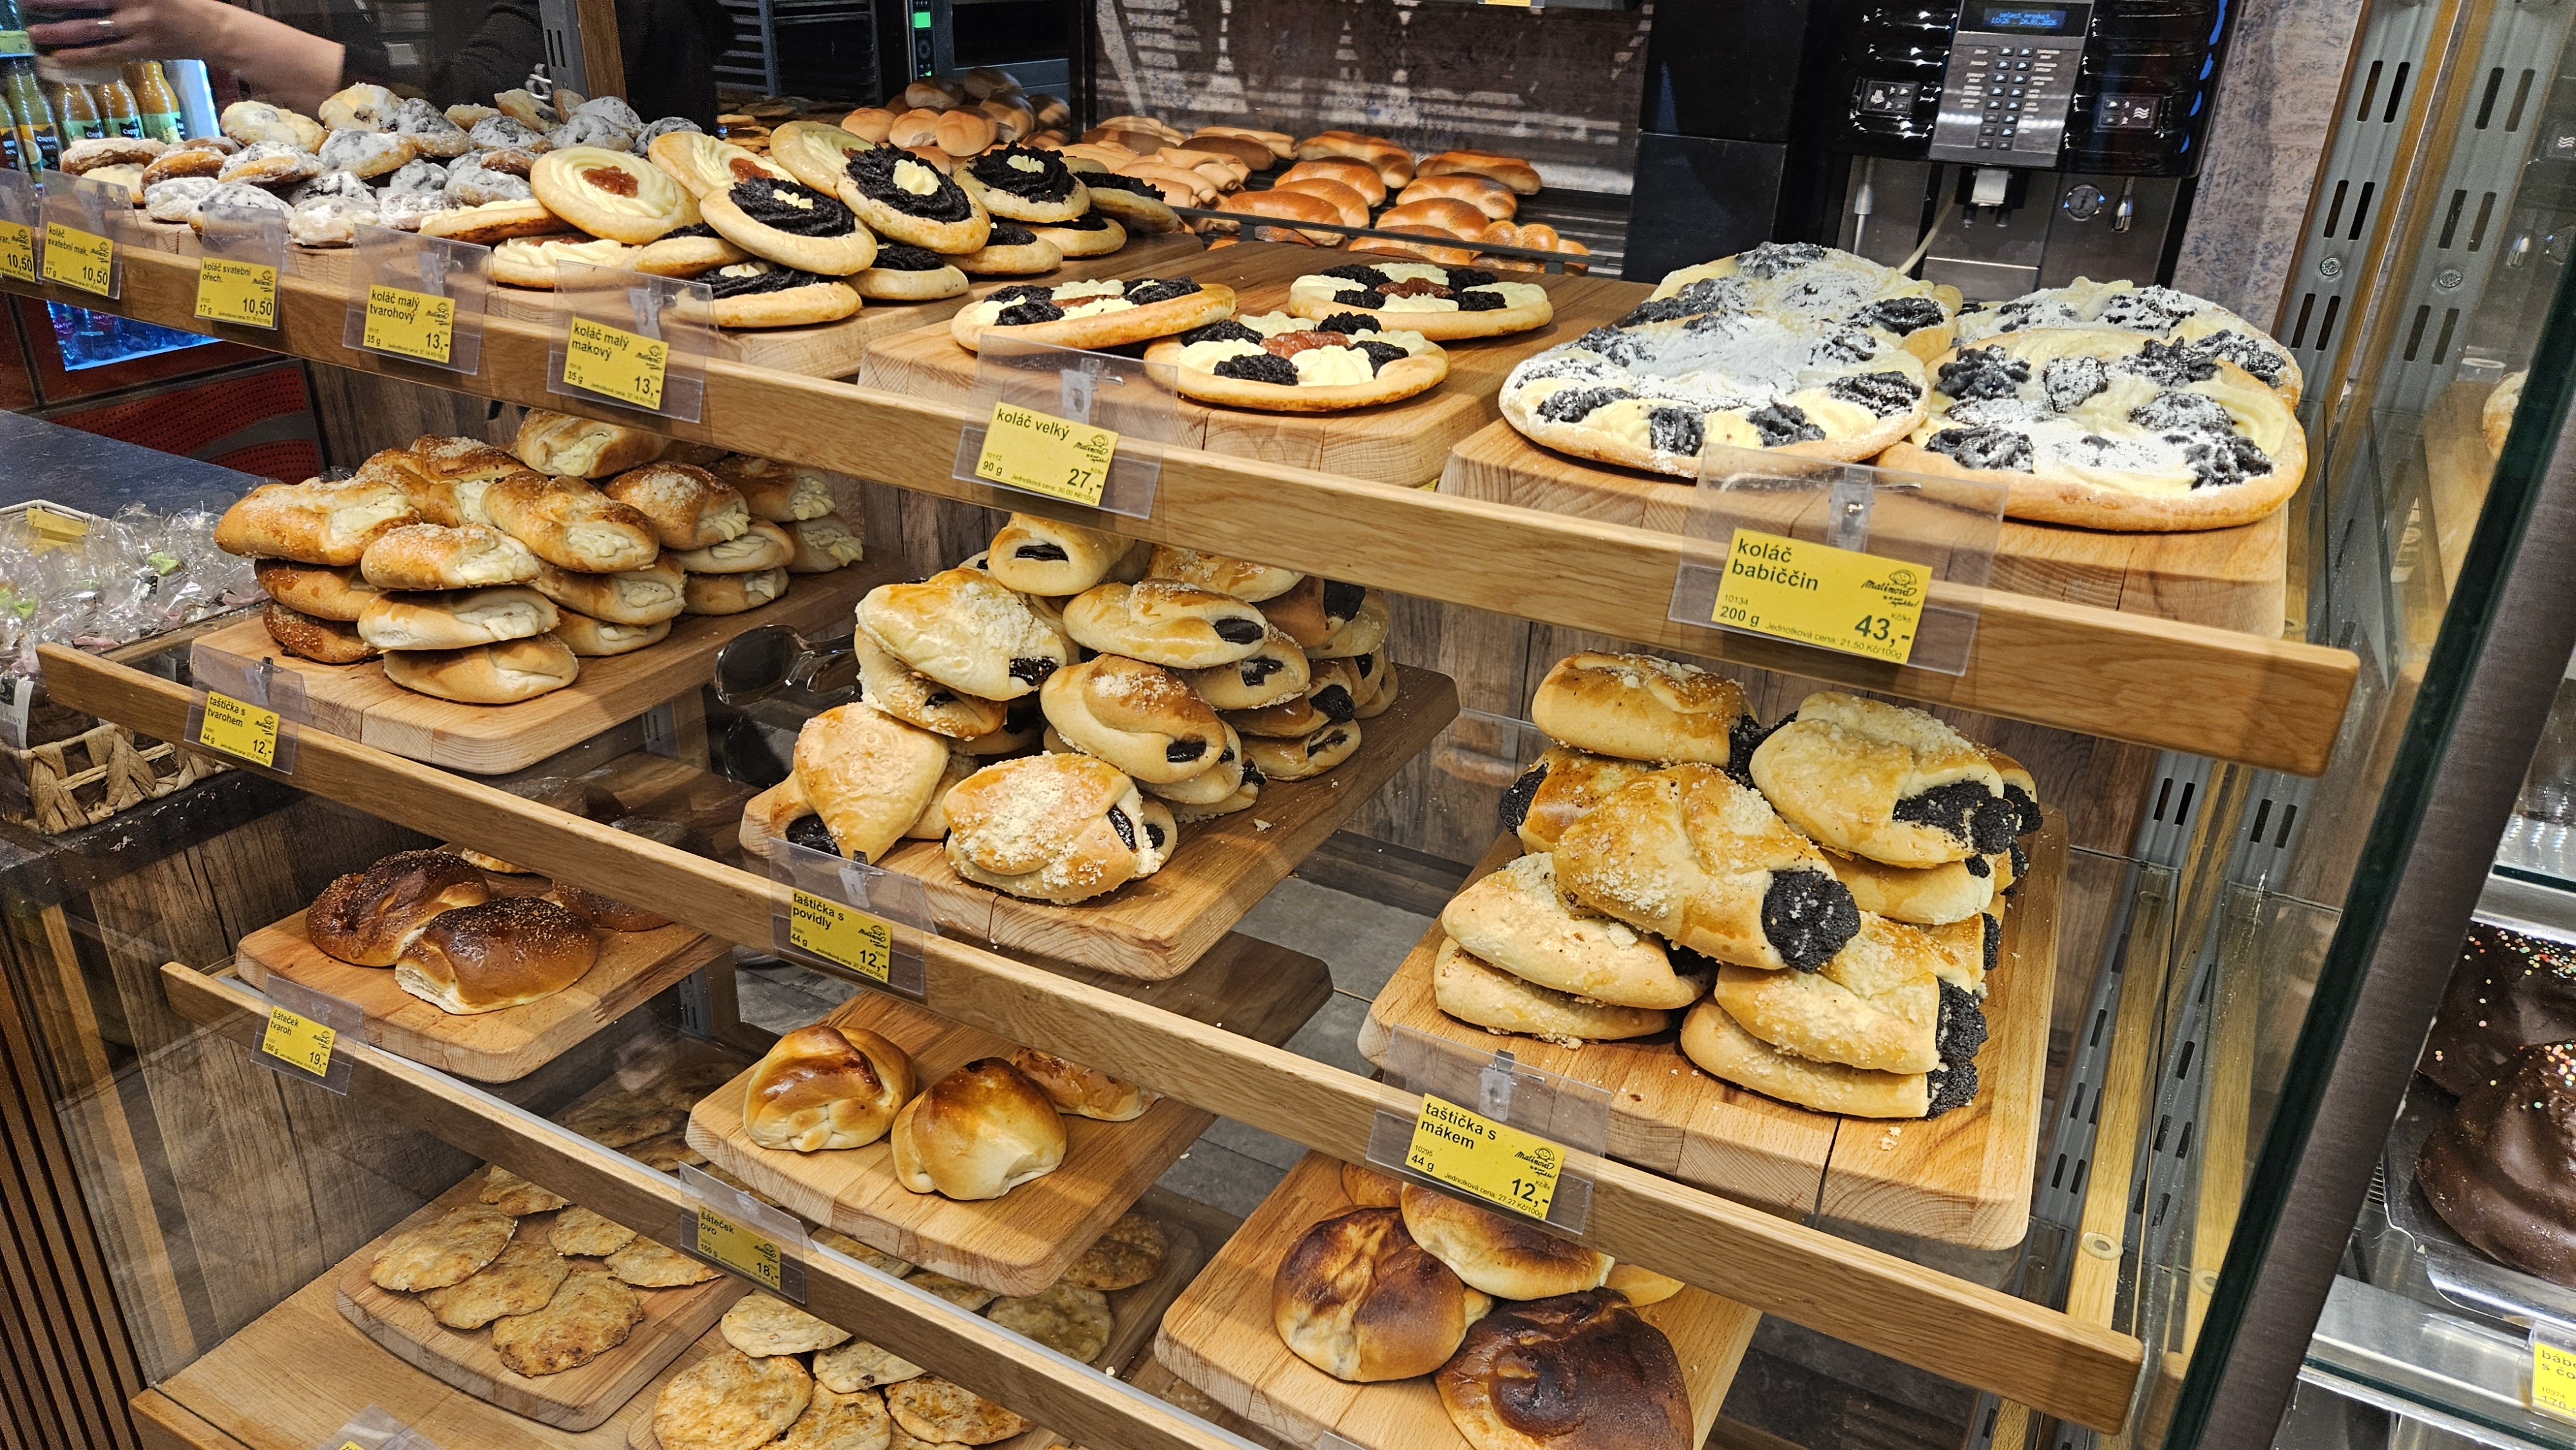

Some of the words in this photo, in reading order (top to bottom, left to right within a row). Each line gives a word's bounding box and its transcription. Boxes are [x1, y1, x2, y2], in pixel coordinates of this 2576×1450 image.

[49, 226, 65, 238] koláč
[48, 238, 73, 250] svatební
[74, 246, 89, 256] mak.
[7, 253, 32, 272] 10,50
[204, 261, 221, 272] koláč
[223, 265, 252, 276] svatební
[82, 266, 108, 285] 10,50
[203, 272, 223, 283] ořech.
[243, 297, 272, 316] 10,50
[371, 289, 396, 304] koláč
[398, 296, 420, 311] malý
[370, 304, 415, 324] tvarohový
[367, 335, 375, 343] 35
[376, 338, 381, 346] g
[426, 332, 449, 353] 13,-
[574, 323, 601, 341] koláč
[604, 333, 629, 351] malý
[571, 340, 612, 361] makový
[568, 371, 576, 381] 35
[634, 375, 660, 399] 13,-
[996, 408, 1032, 428] koláč
[1036, 420, 1070, 440] velký
[983, 461, 994, 471] 90
[996, 467, 1003, 476] g
[1011, 473, 1042, 487] Jednotková
[1067, 468, 1102, 494] 27,-
[1738, 538, 1792, 563] koláč
[1732, 558, 1819, 591] babiččin
[1725, 594, 1748, 606] 10134
[1719, 606, 1746, 622] 200
[1750, 615, 1760, 627] g
[1854, 614, 1910, 648] 43,-
[1765, 622, 1812, 639] Jednotková
[1814, 632, 1839, 645] cena:
[1840, 638, 1864, 652] 21.50
[1866, 645, 1902, 660] Kč/100g
[209, 696, 239, 714] taštička
[207, 708, 243, 728] tvarohem
[203, 733, 210, 741] 44
[253, 739, 272, 757] 12,-
[793, 892, 835, 918] taštička
[838, 912, 844, 921] s
[793, 907, 832, 930] povidly
[791, 933, 800, 943] 44
[802, 939, 808, 947] g
[860, 950, 887, 972] 12,-
[270, 1021, 292, 1036] tvaroh
[272, 1010, 299, 1028] šáteček
[265, 1043, 274, 1051] 100
[310, 1051, 327, 1069] 19,-
[1426, 1102, 1484, 1136] taštička
[1488, 1129, 1497, 1140] s
[1421, 1120, 1475, 1149] mákem
[1415, 1145, 1433, 1156] 10295
[1412, 1154, 1424, 1166] 44
[1427, 1162, 1435, 1172] g
[1444, 1172, 1479, 1191] Jednotková
[1480, 1187, 1497, 1198] cena:
[1498, 1194, 1516, 1206] 27.27
[1517, 1202, 1544, 1219] Kč/100g
[1512, 1178, 1549, 1208] 12,-
[701, 1211, 734, 1234] šáteček
[701, 1223, 717, 1235] ovo
[701, 1244, 712, 1254] 100
[757, 1263, 779, 1281] 18,-
[2541, 1396, 2566, 1409] 170
